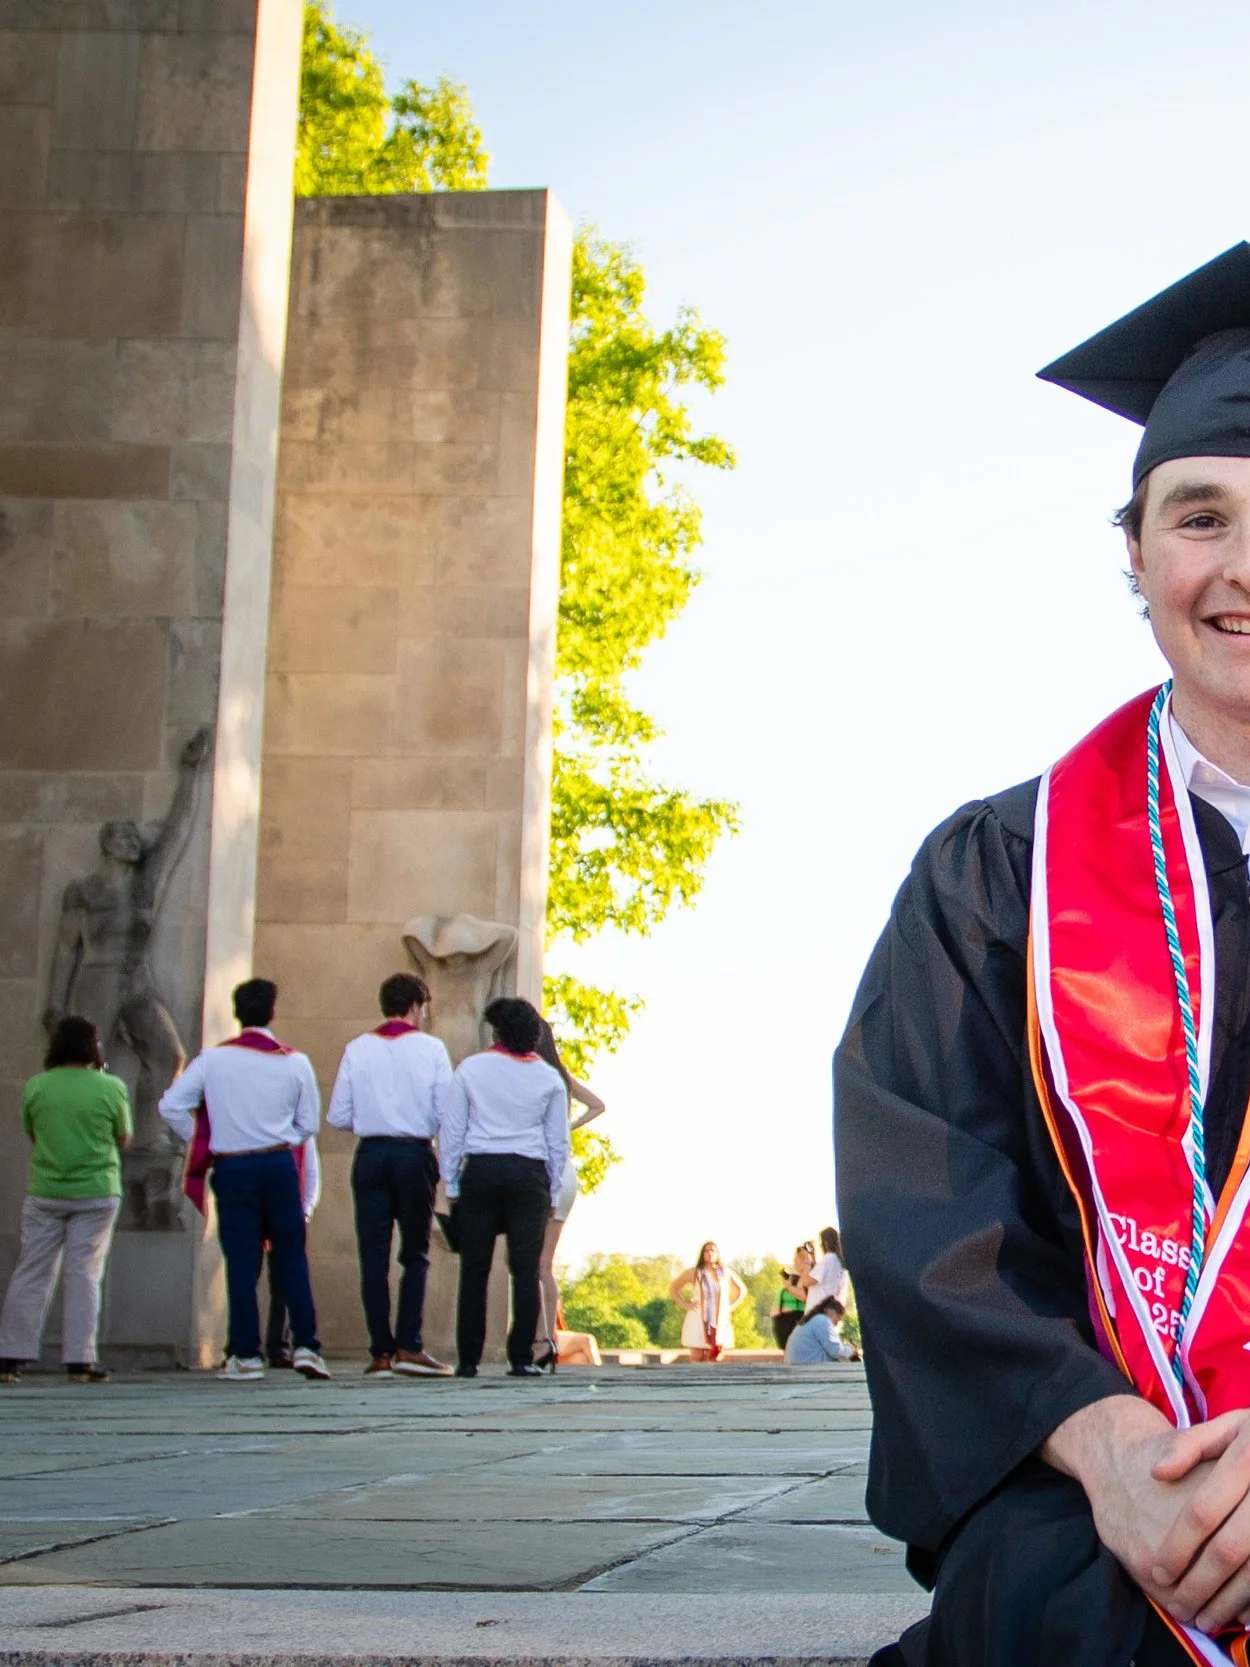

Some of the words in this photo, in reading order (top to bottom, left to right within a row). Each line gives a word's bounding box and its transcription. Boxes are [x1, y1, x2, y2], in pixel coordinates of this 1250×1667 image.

[1107, 1212, 1192, 1271] Class
[1133, 1266, 1167, 1299] of
[1147, 1301, 1182, 1341] 25
